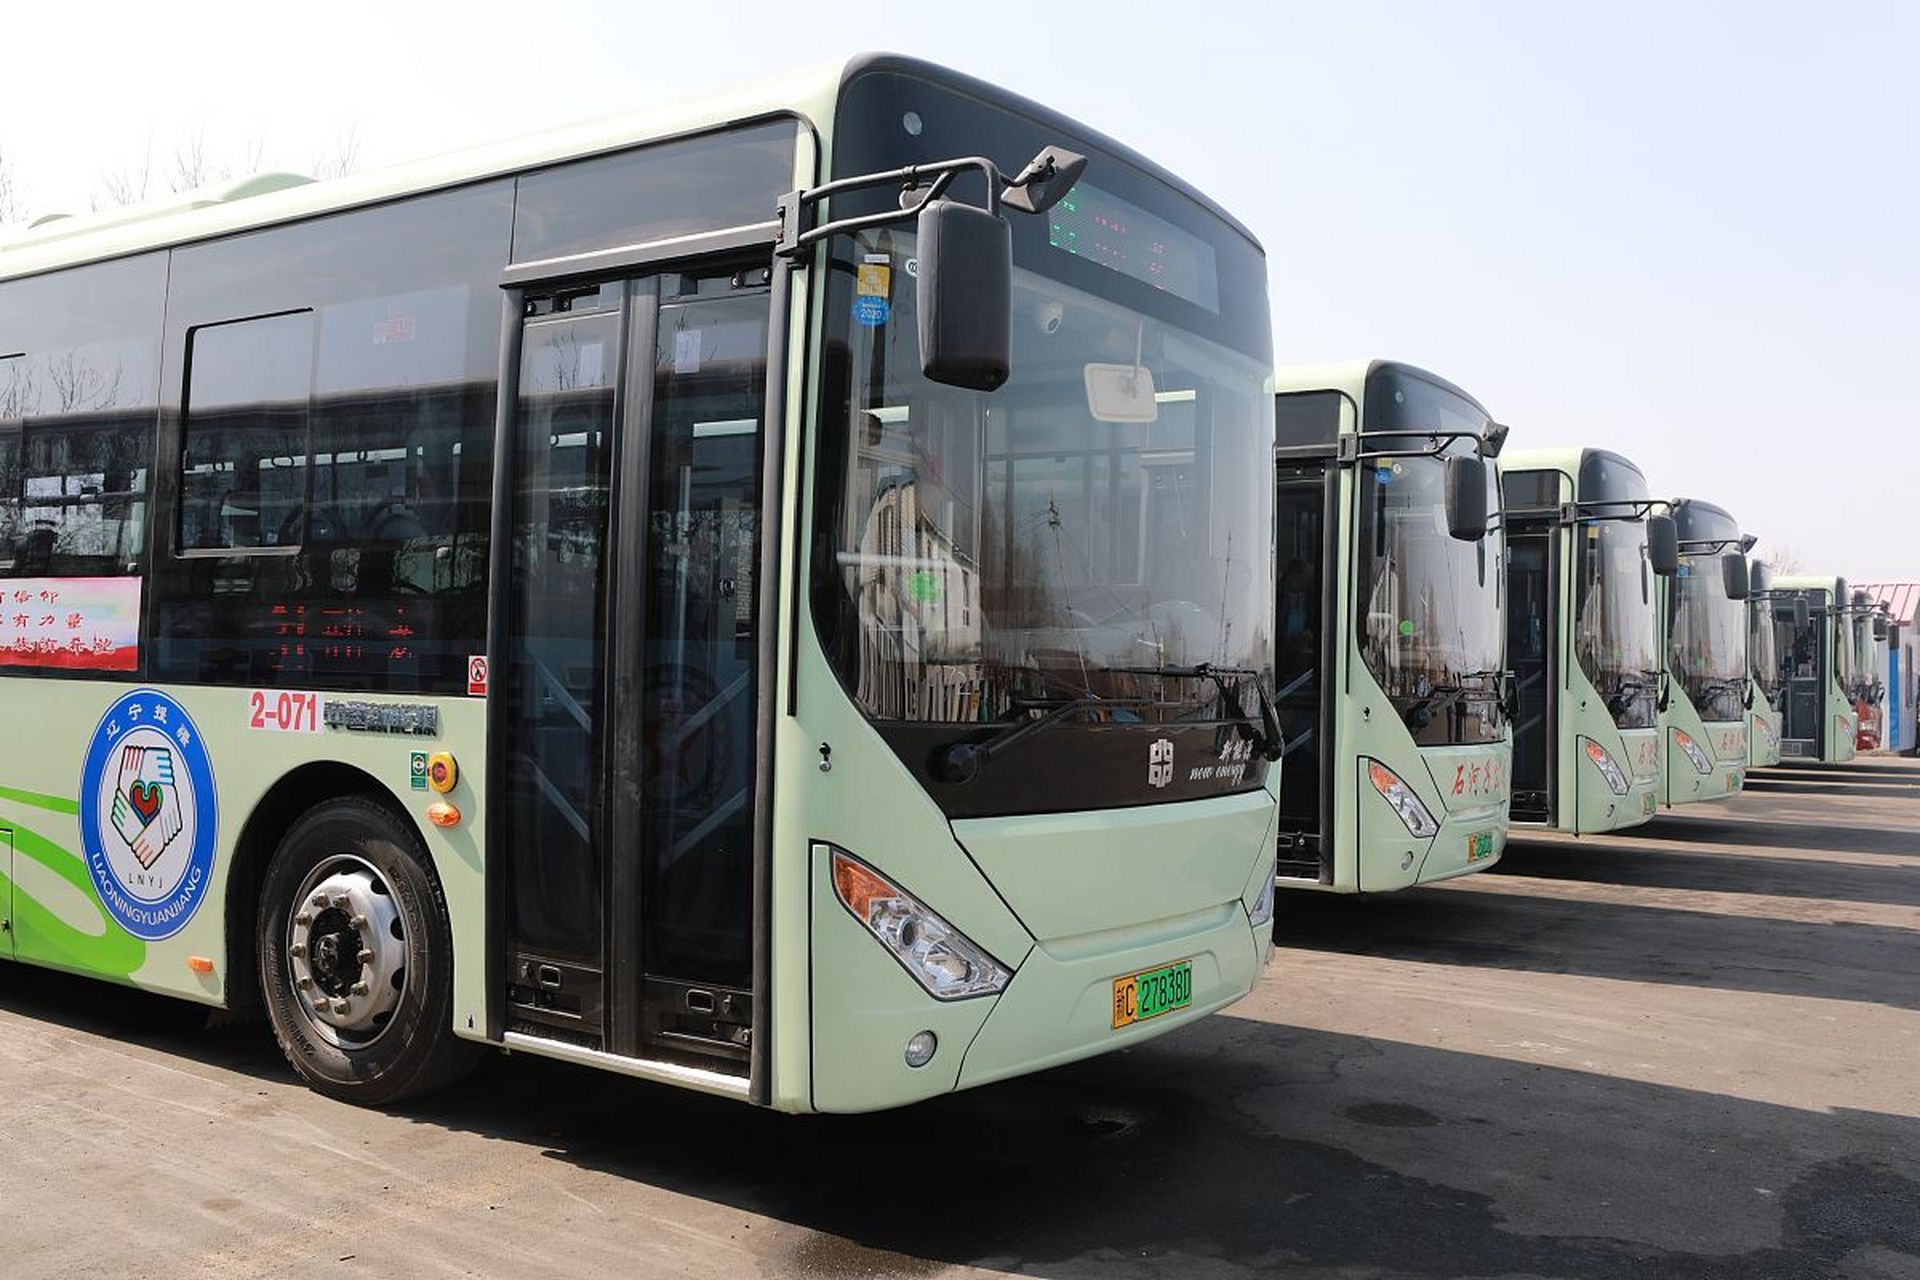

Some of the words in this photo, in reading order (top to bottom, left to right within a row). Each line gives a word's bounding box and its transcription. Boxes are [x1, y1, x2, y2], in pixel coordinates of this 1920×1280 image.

[0, 613, 84, 629] 有力量
[251, 691, 317, 732] 2-071
[92, 852, 201, 925] LIAONINGYUANJIANG
